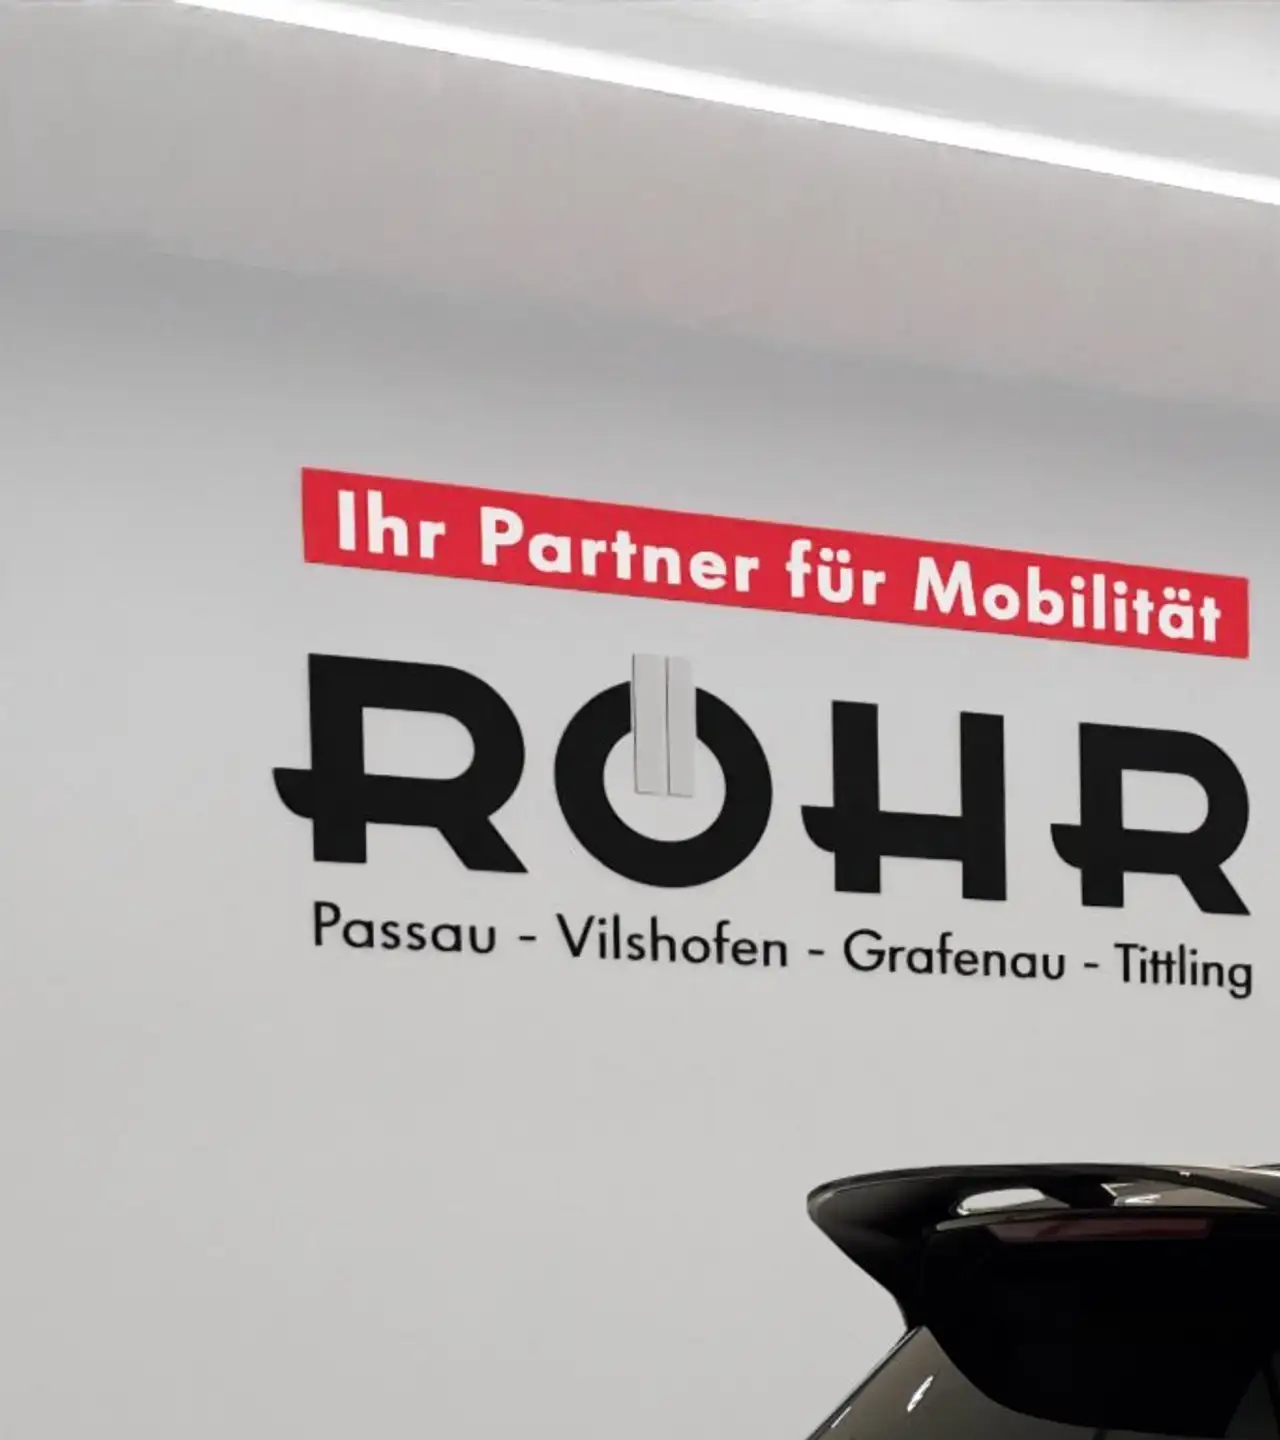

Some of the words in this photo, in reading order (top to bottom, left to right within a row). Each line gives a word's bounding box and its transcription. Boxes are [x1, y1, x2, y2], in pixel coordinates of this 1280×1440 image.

[338, 489, 446, 559] Ihr
[480, 506, 758, 592] Partner
[785, 539, 886, 605] für
[914, 556, 1221, 642] Mobilität
[313, 900, 496, 954] Passau
[556, 913, 787, 967] Vilshofen
[843, 928, 1065, 980] Grafenau
[1113, 942, 1252, 1000] Tittling
